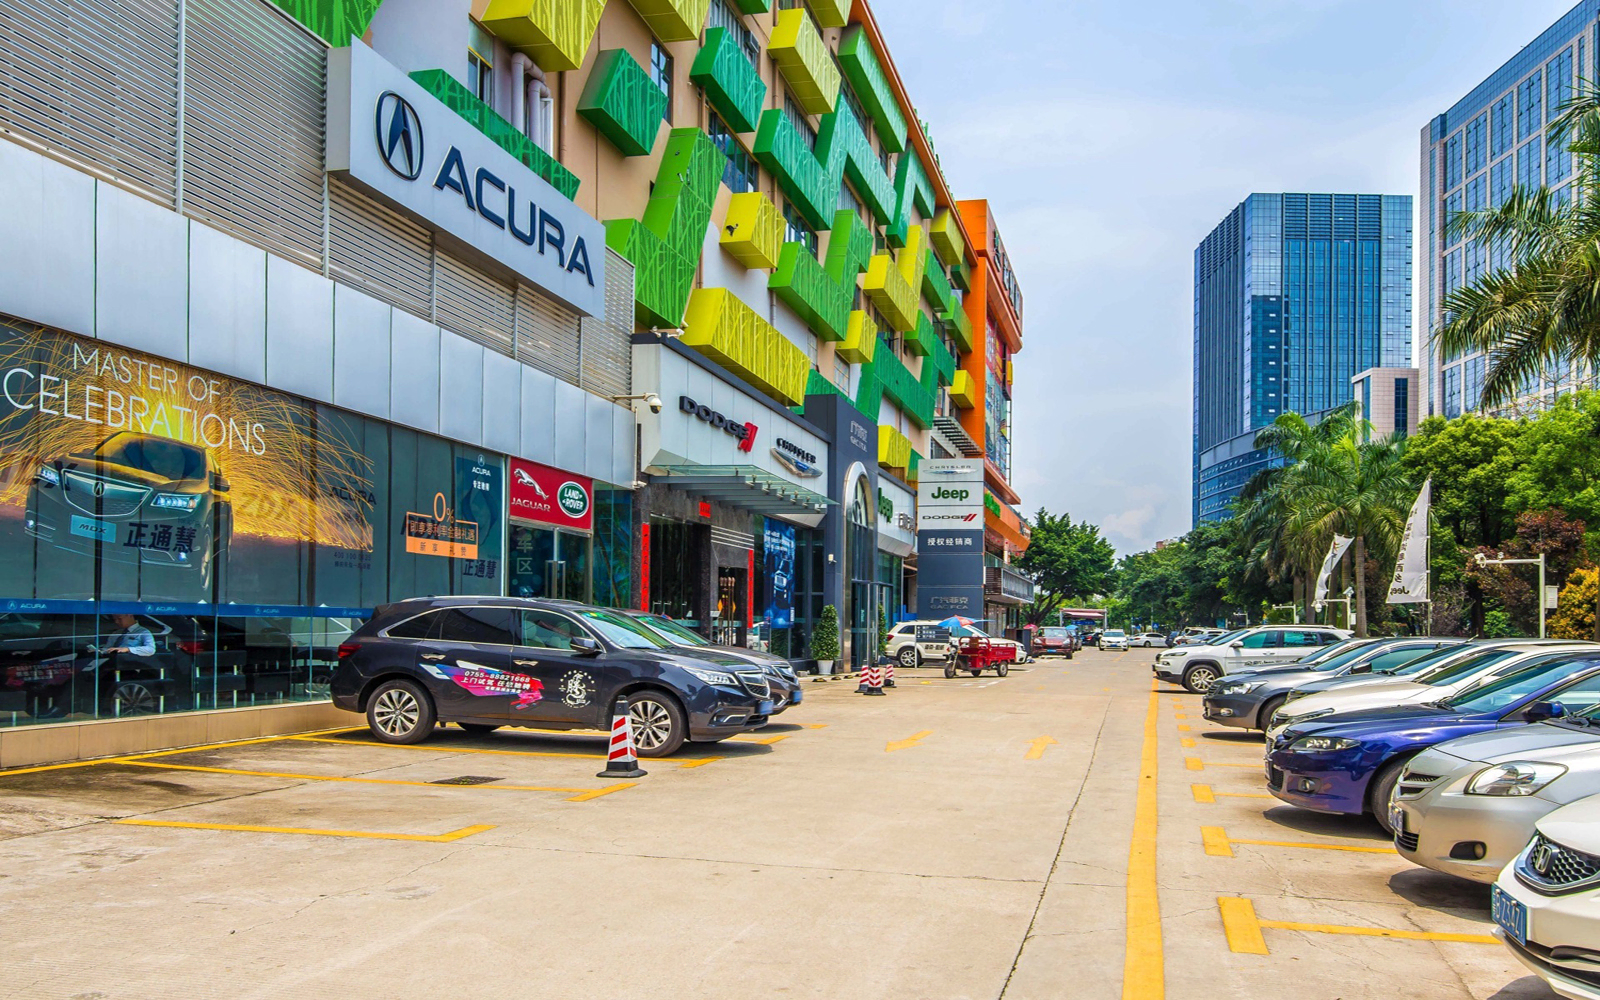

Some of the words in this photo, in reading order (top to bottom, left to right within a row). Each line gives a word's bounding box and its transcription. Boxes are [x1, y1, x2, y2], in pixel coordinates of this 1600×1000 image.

[432, 144, 595, 287] ACURA
[74, 343, 178, 394] MASTER
[188, 375, 220, 404] OF
[3, 368, 266, 456] CELEBRATIONS
[679, 395, 750, 441] DODGE
[776, 436, 817, 464] CHRYSLER
[471, 466, 492, 477] ACURA
[564, 488, 580, 499] LAND
[931, 486, 969, 502] Jeep
[433, 491, 455, 524] 0%
[511, 497, 551, 512] JAGUAR
[565, 498, 584, 510] ROVER
[79, 523, 107, 534] MDX
[123, 522, 197, 553] 正通慧
[927, 537, 973, 546] 授权经销商
[463, 559, 497, 579] 正通慧
